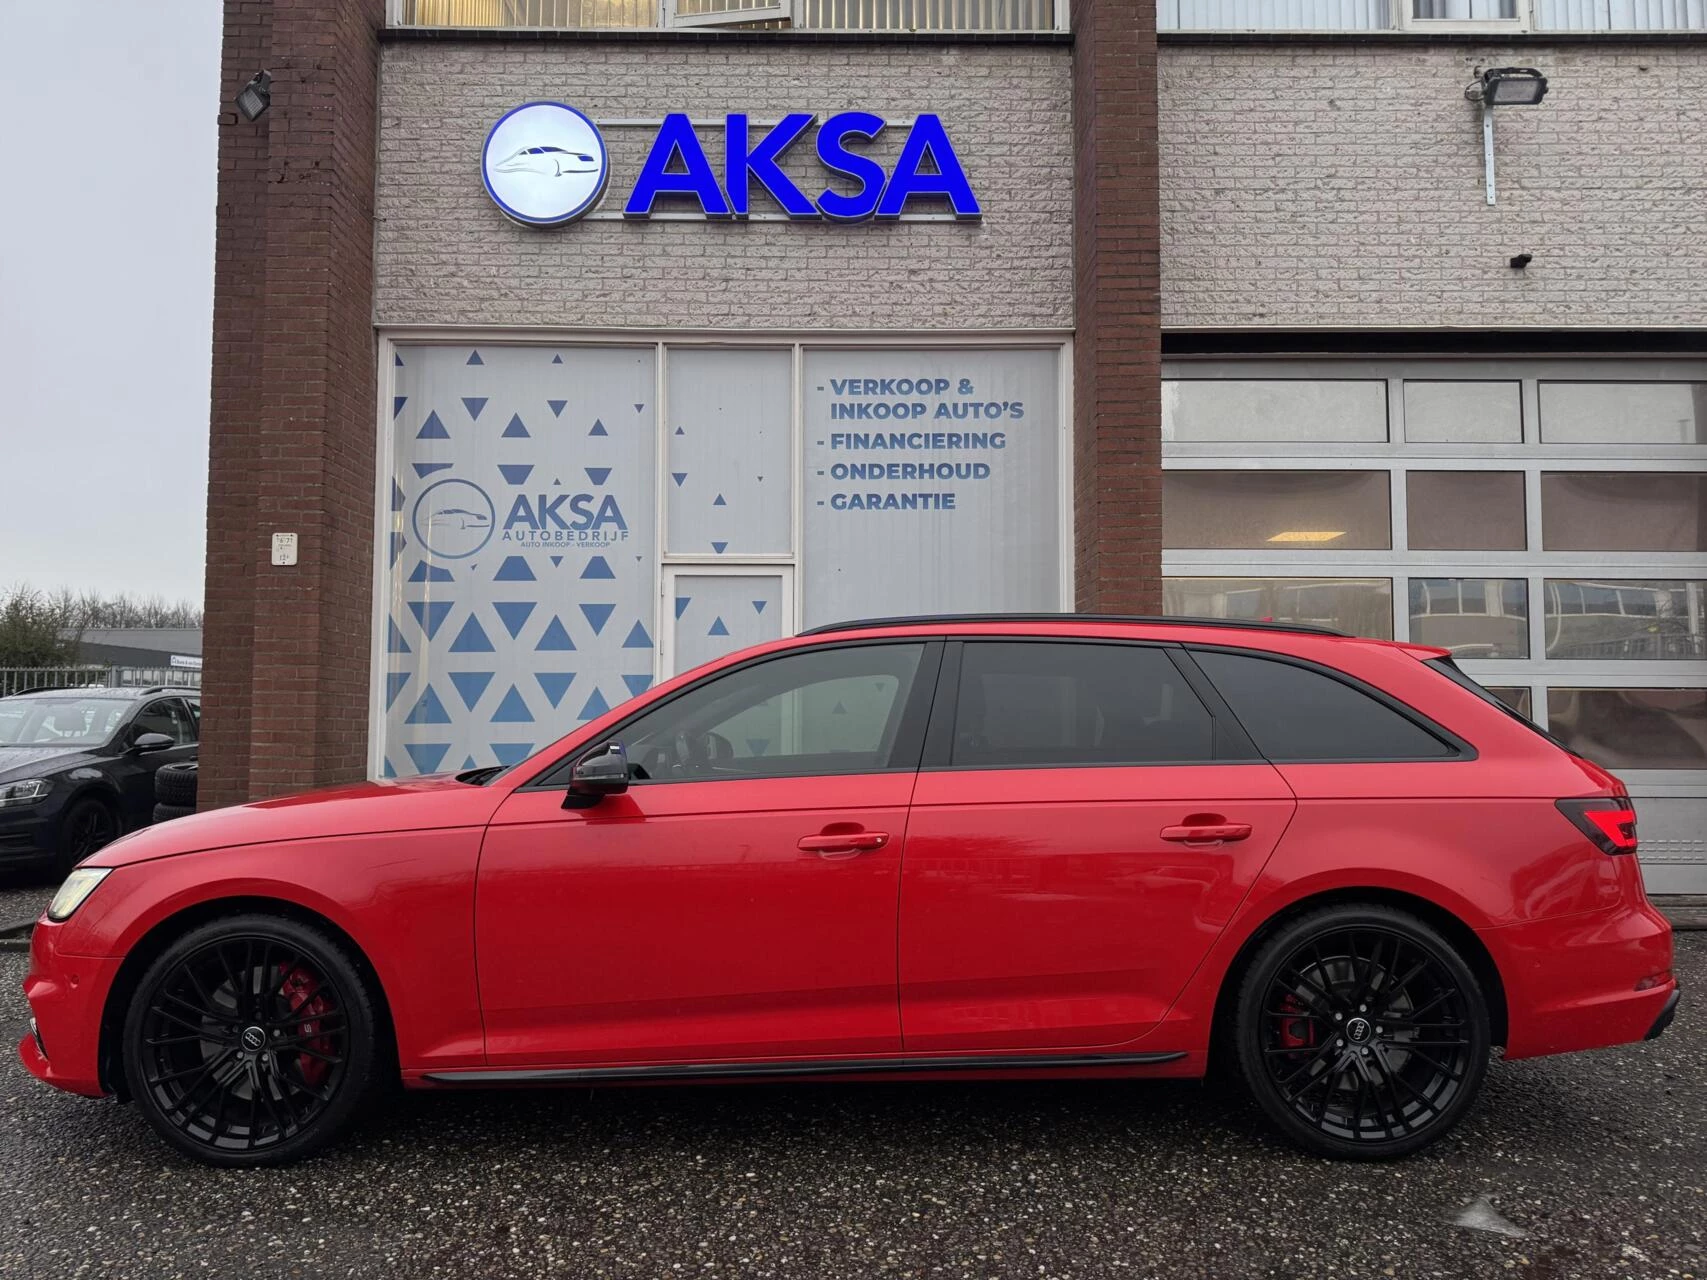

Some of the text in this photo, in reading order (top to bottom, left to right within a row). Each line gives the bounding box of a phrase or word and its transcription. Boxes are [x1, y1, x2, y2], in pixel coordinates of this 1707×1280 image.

[624, 111, 982, 222] AKSA
[830, 378, 950, 396] VERKOOP
[957, 378, 974, 396] &
[831, 401, 1025, 420] INKOOP AUTO'S
[831, 432, 1007, 450] FINANCIERING
[830, 462, 991, 481] ONDERHOUD
[830, 493, 956, 511] GARANTIE
[503, 494, 628, 530] AKSA
[502, 530, 629, 541] AUTOBEDRIJF
